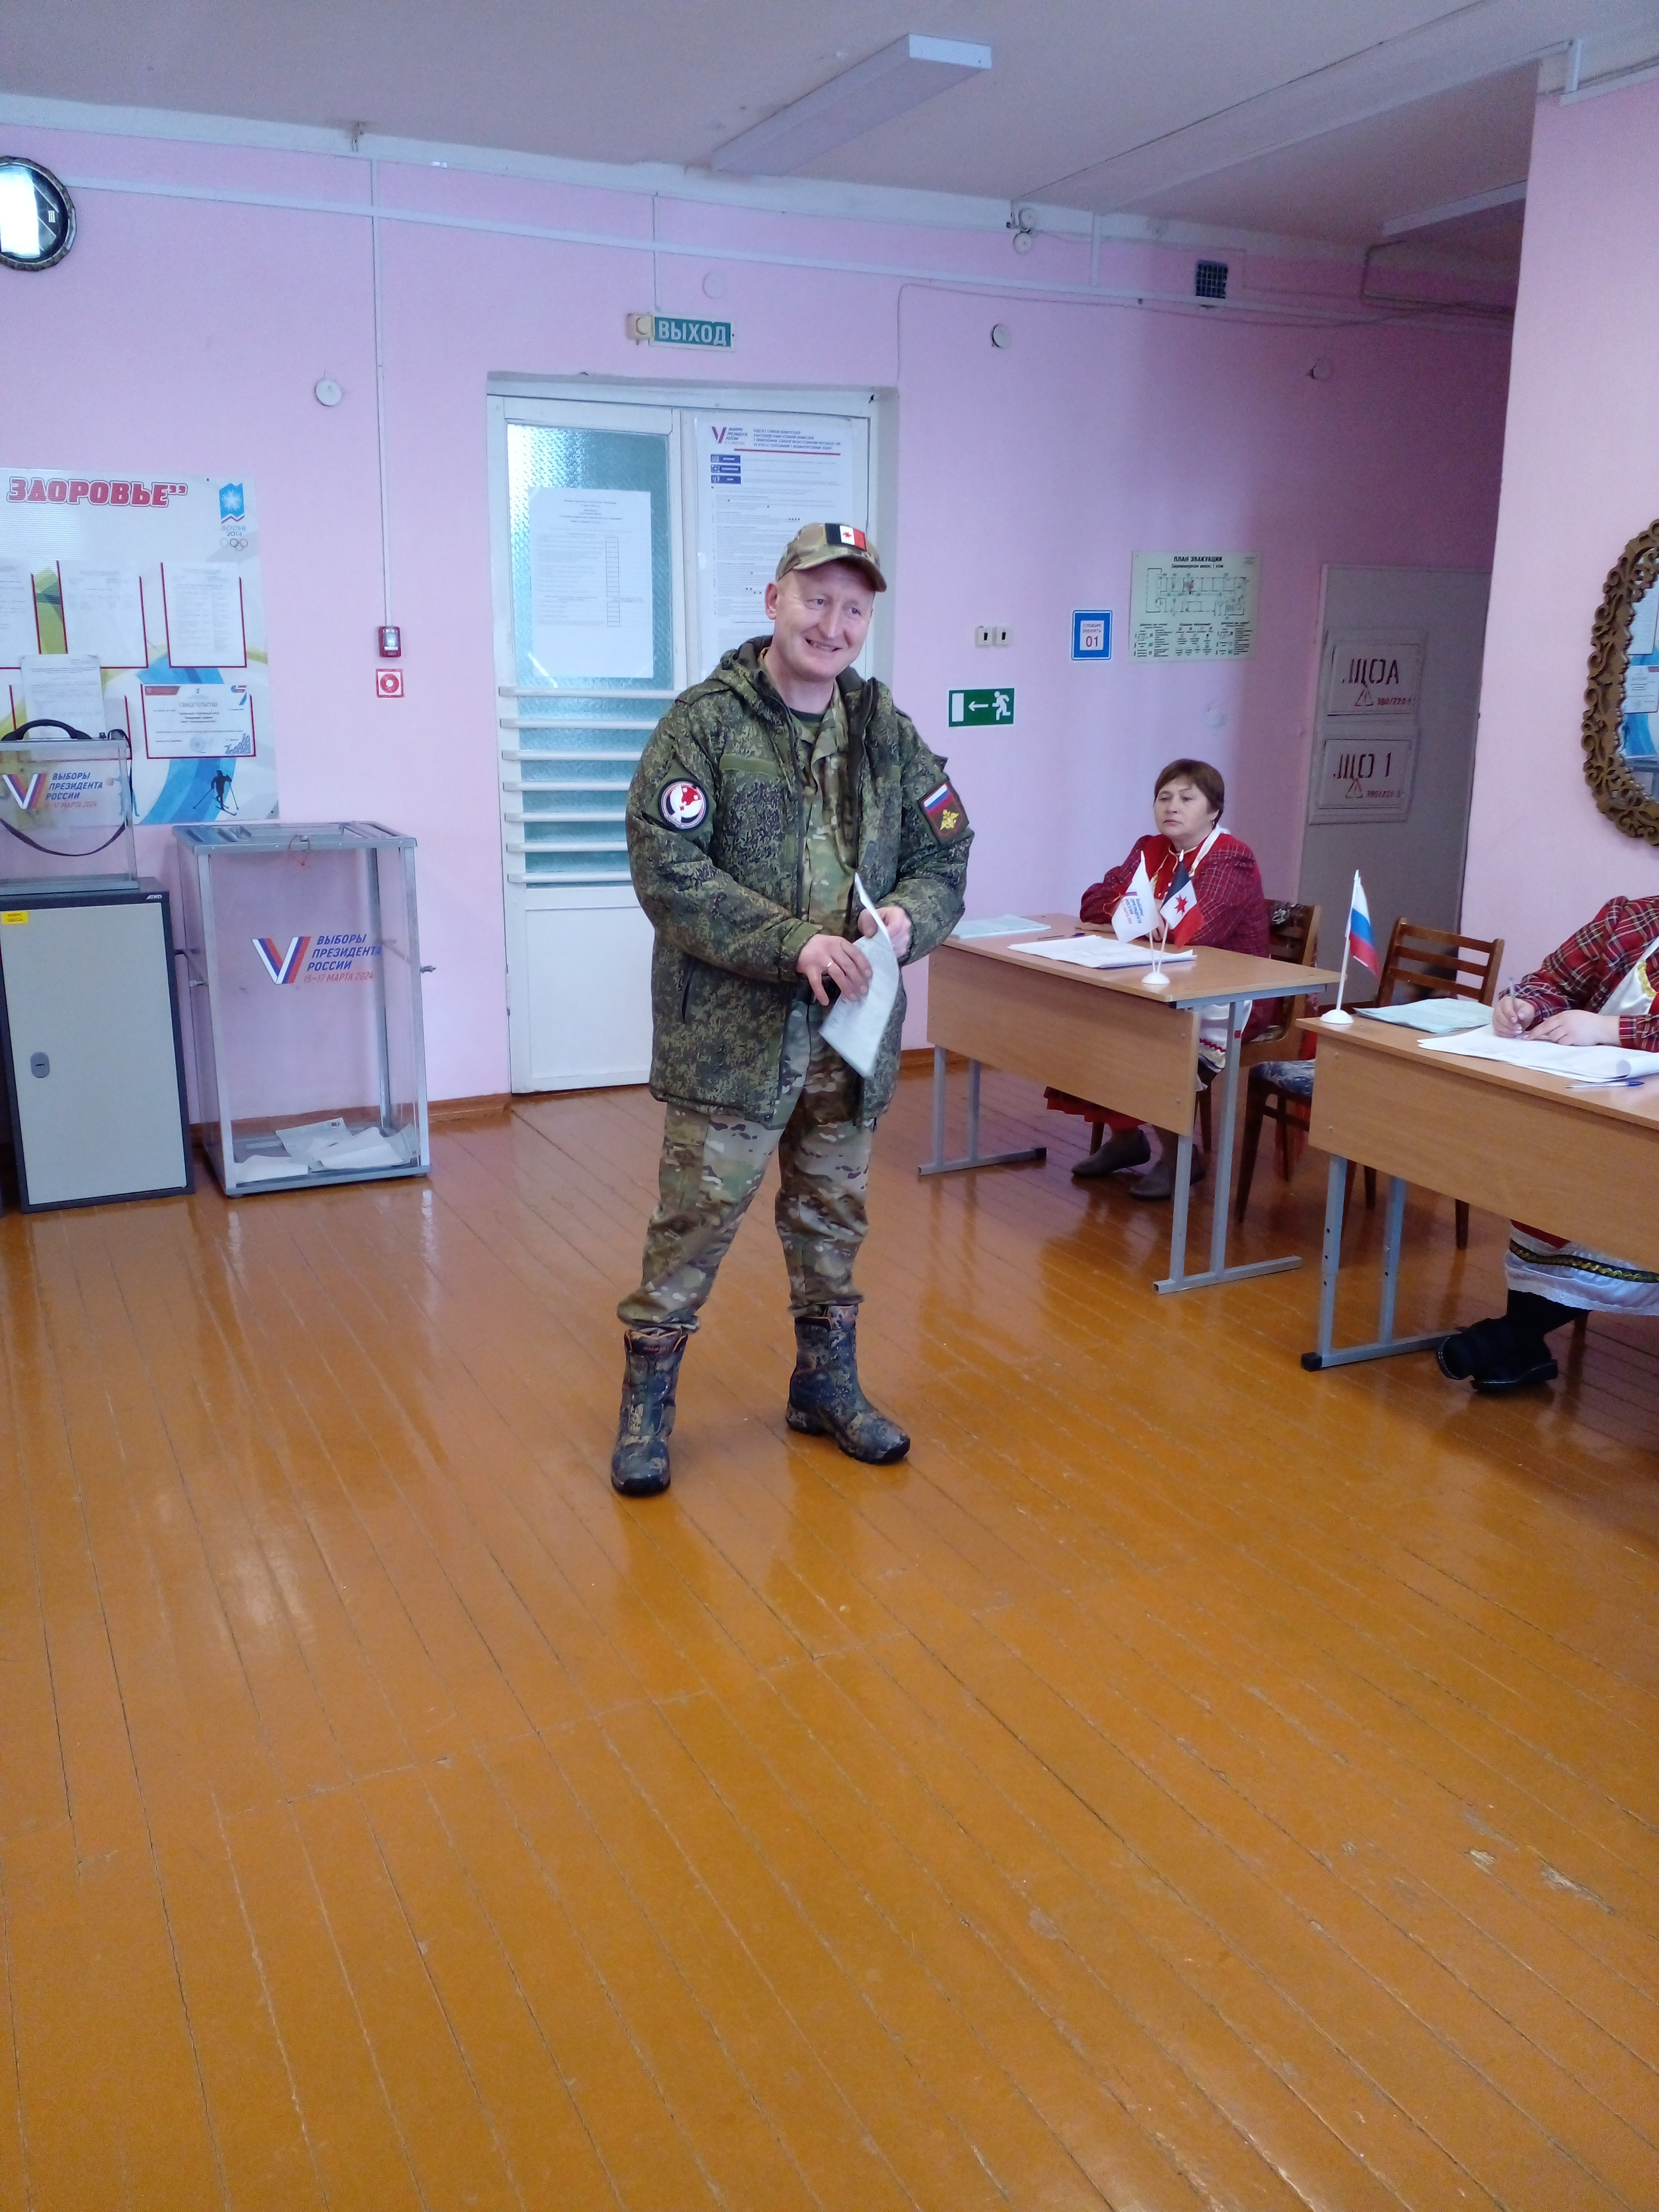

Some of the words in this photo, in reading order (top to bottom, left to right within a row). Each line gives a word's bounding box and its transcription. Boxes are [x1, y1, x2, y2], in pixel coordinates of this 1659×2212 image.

[658, 320, 726, 346] ВЫХОД
[1086, 636, 1098, 648] 01
[52, 772, 91, 780] ВЫБОРЫ
[49, 781, 103, 790] ПРЕЗИДЕНТА
[316, 934, 367, 945] ВЫБОРЫ
[312, 946, 382, 958] ПРЕЗИДЕНТА
[307, 960, 352, 972] РОССИИ
[326, 973, 353, 982] МАРТА
[354, 972, 374, 981] 2024
